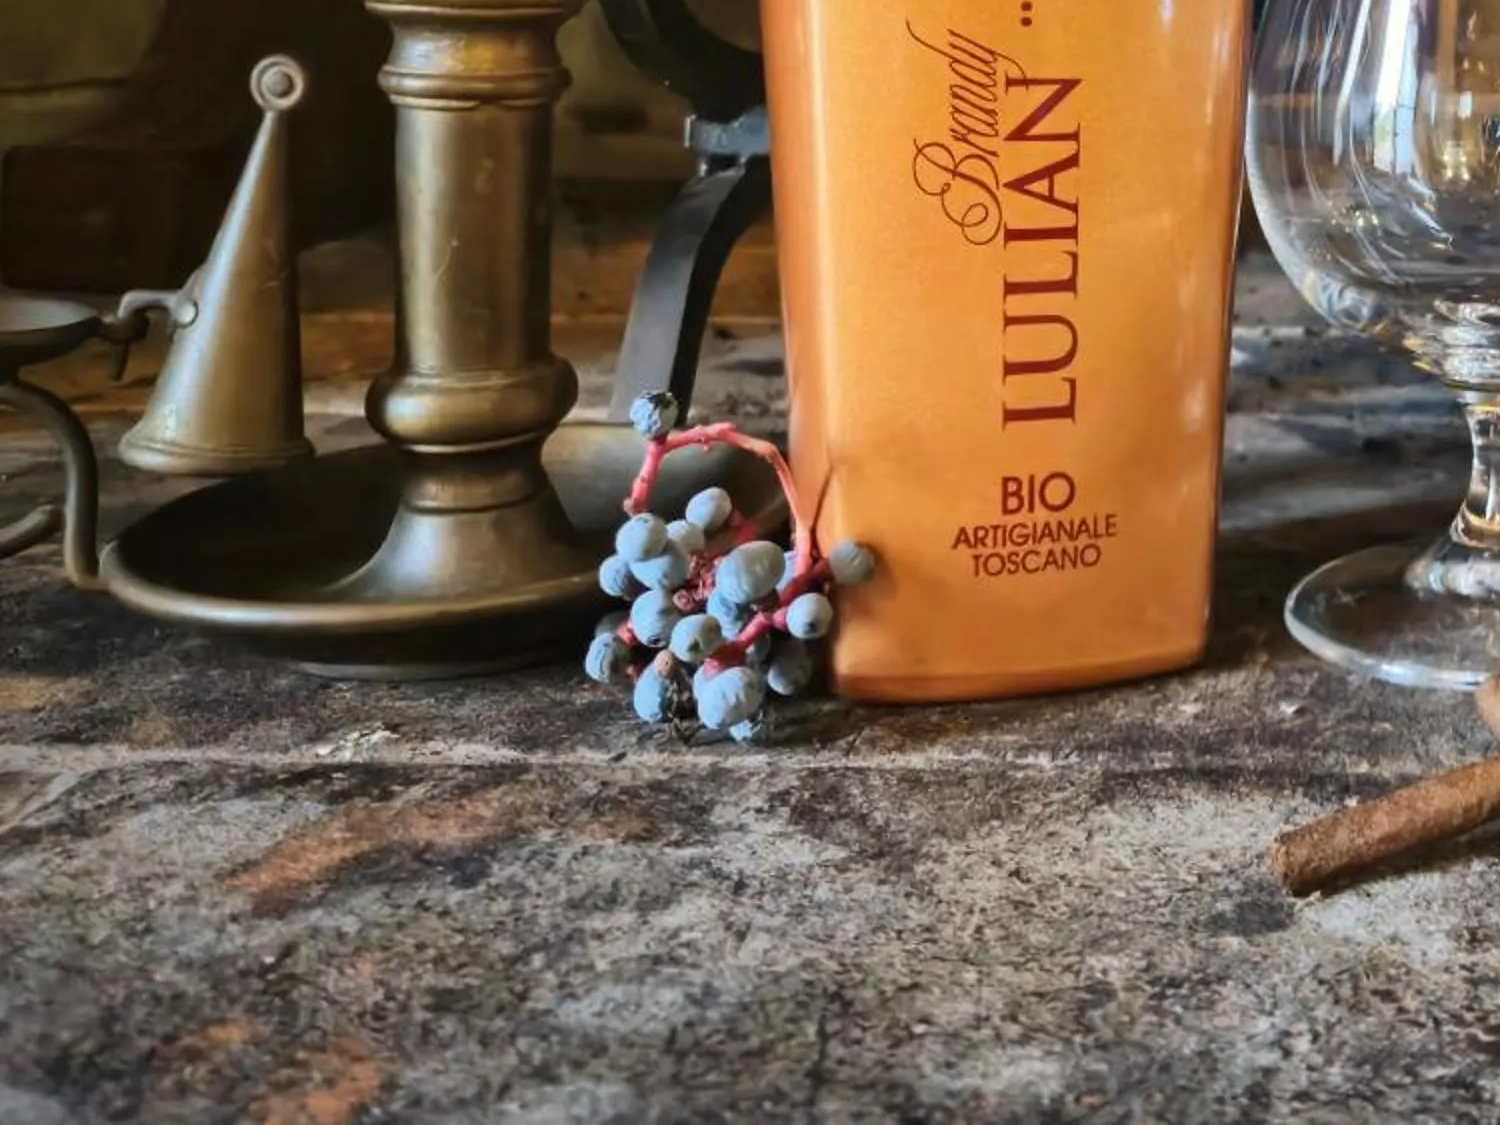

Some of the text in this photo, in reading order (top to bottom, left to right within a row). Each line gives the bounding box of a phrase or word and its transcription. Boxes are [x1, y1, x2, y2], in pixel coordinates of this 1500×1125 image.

[906, 19, 1029, 246] Brandy
[1002, 70, 1083, 433] LULIAN
[1001, 471, 1076, 516] BIO
[951, 512, 1119, 551] ARTIGIANALE
[971, 543, 1102, 578] TOSCANO
